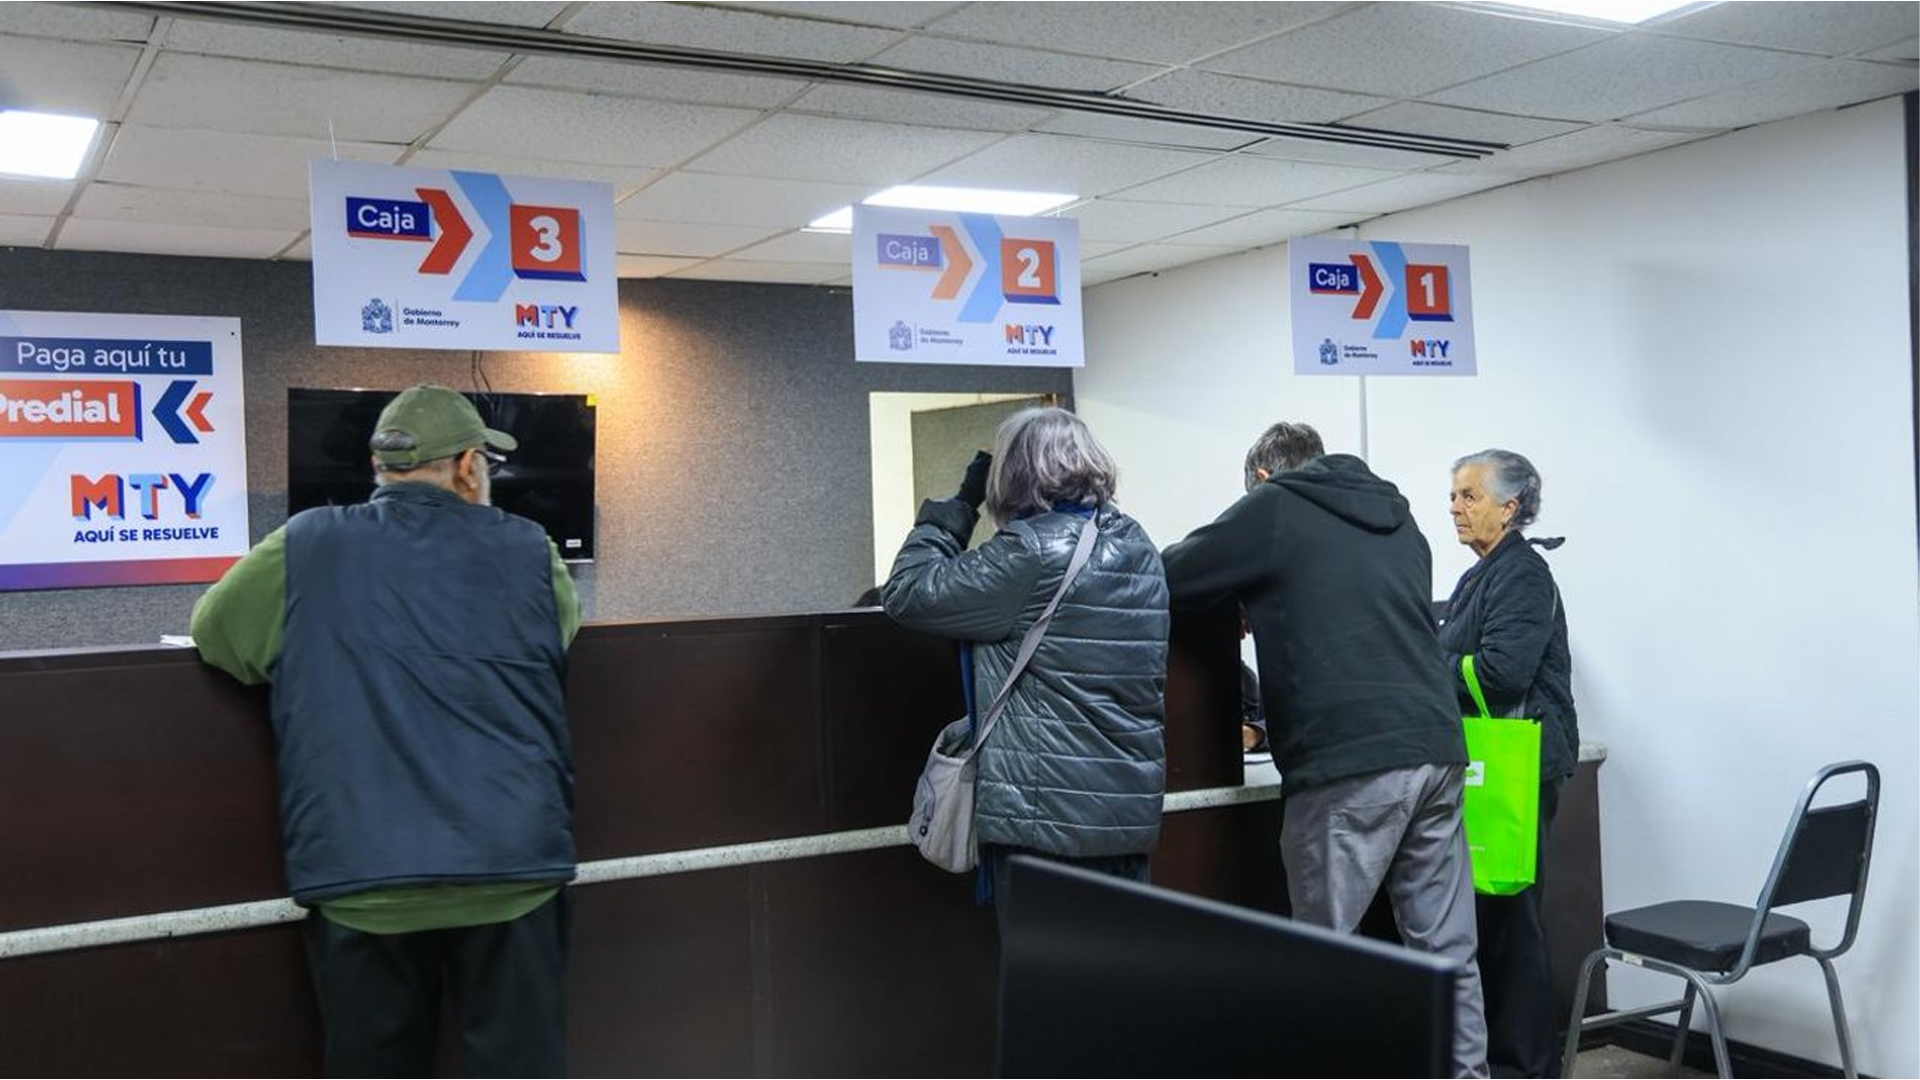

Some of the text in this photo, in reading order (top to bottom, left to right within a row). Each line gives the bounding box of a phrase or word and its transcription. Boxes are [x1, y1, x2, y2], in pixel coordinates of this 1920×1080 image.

[357, 205, 563, 262] Caja 3
[886, 240, 1041, 288] Caja 2
[1315, 269, 1435, 308] Caja 1
[403, 317, 415, 325] de
[515, 303, 580, 329] MTY
[1005, 324, 1055, 346] MTY
[1410, 339, 1450, 358] MTY
[17, 342, 187, 372] Paga aquí tu
[71, 473, 217, 520] MTY
[73, 525, 220, 543] AQUÍ SE RESUELVE
